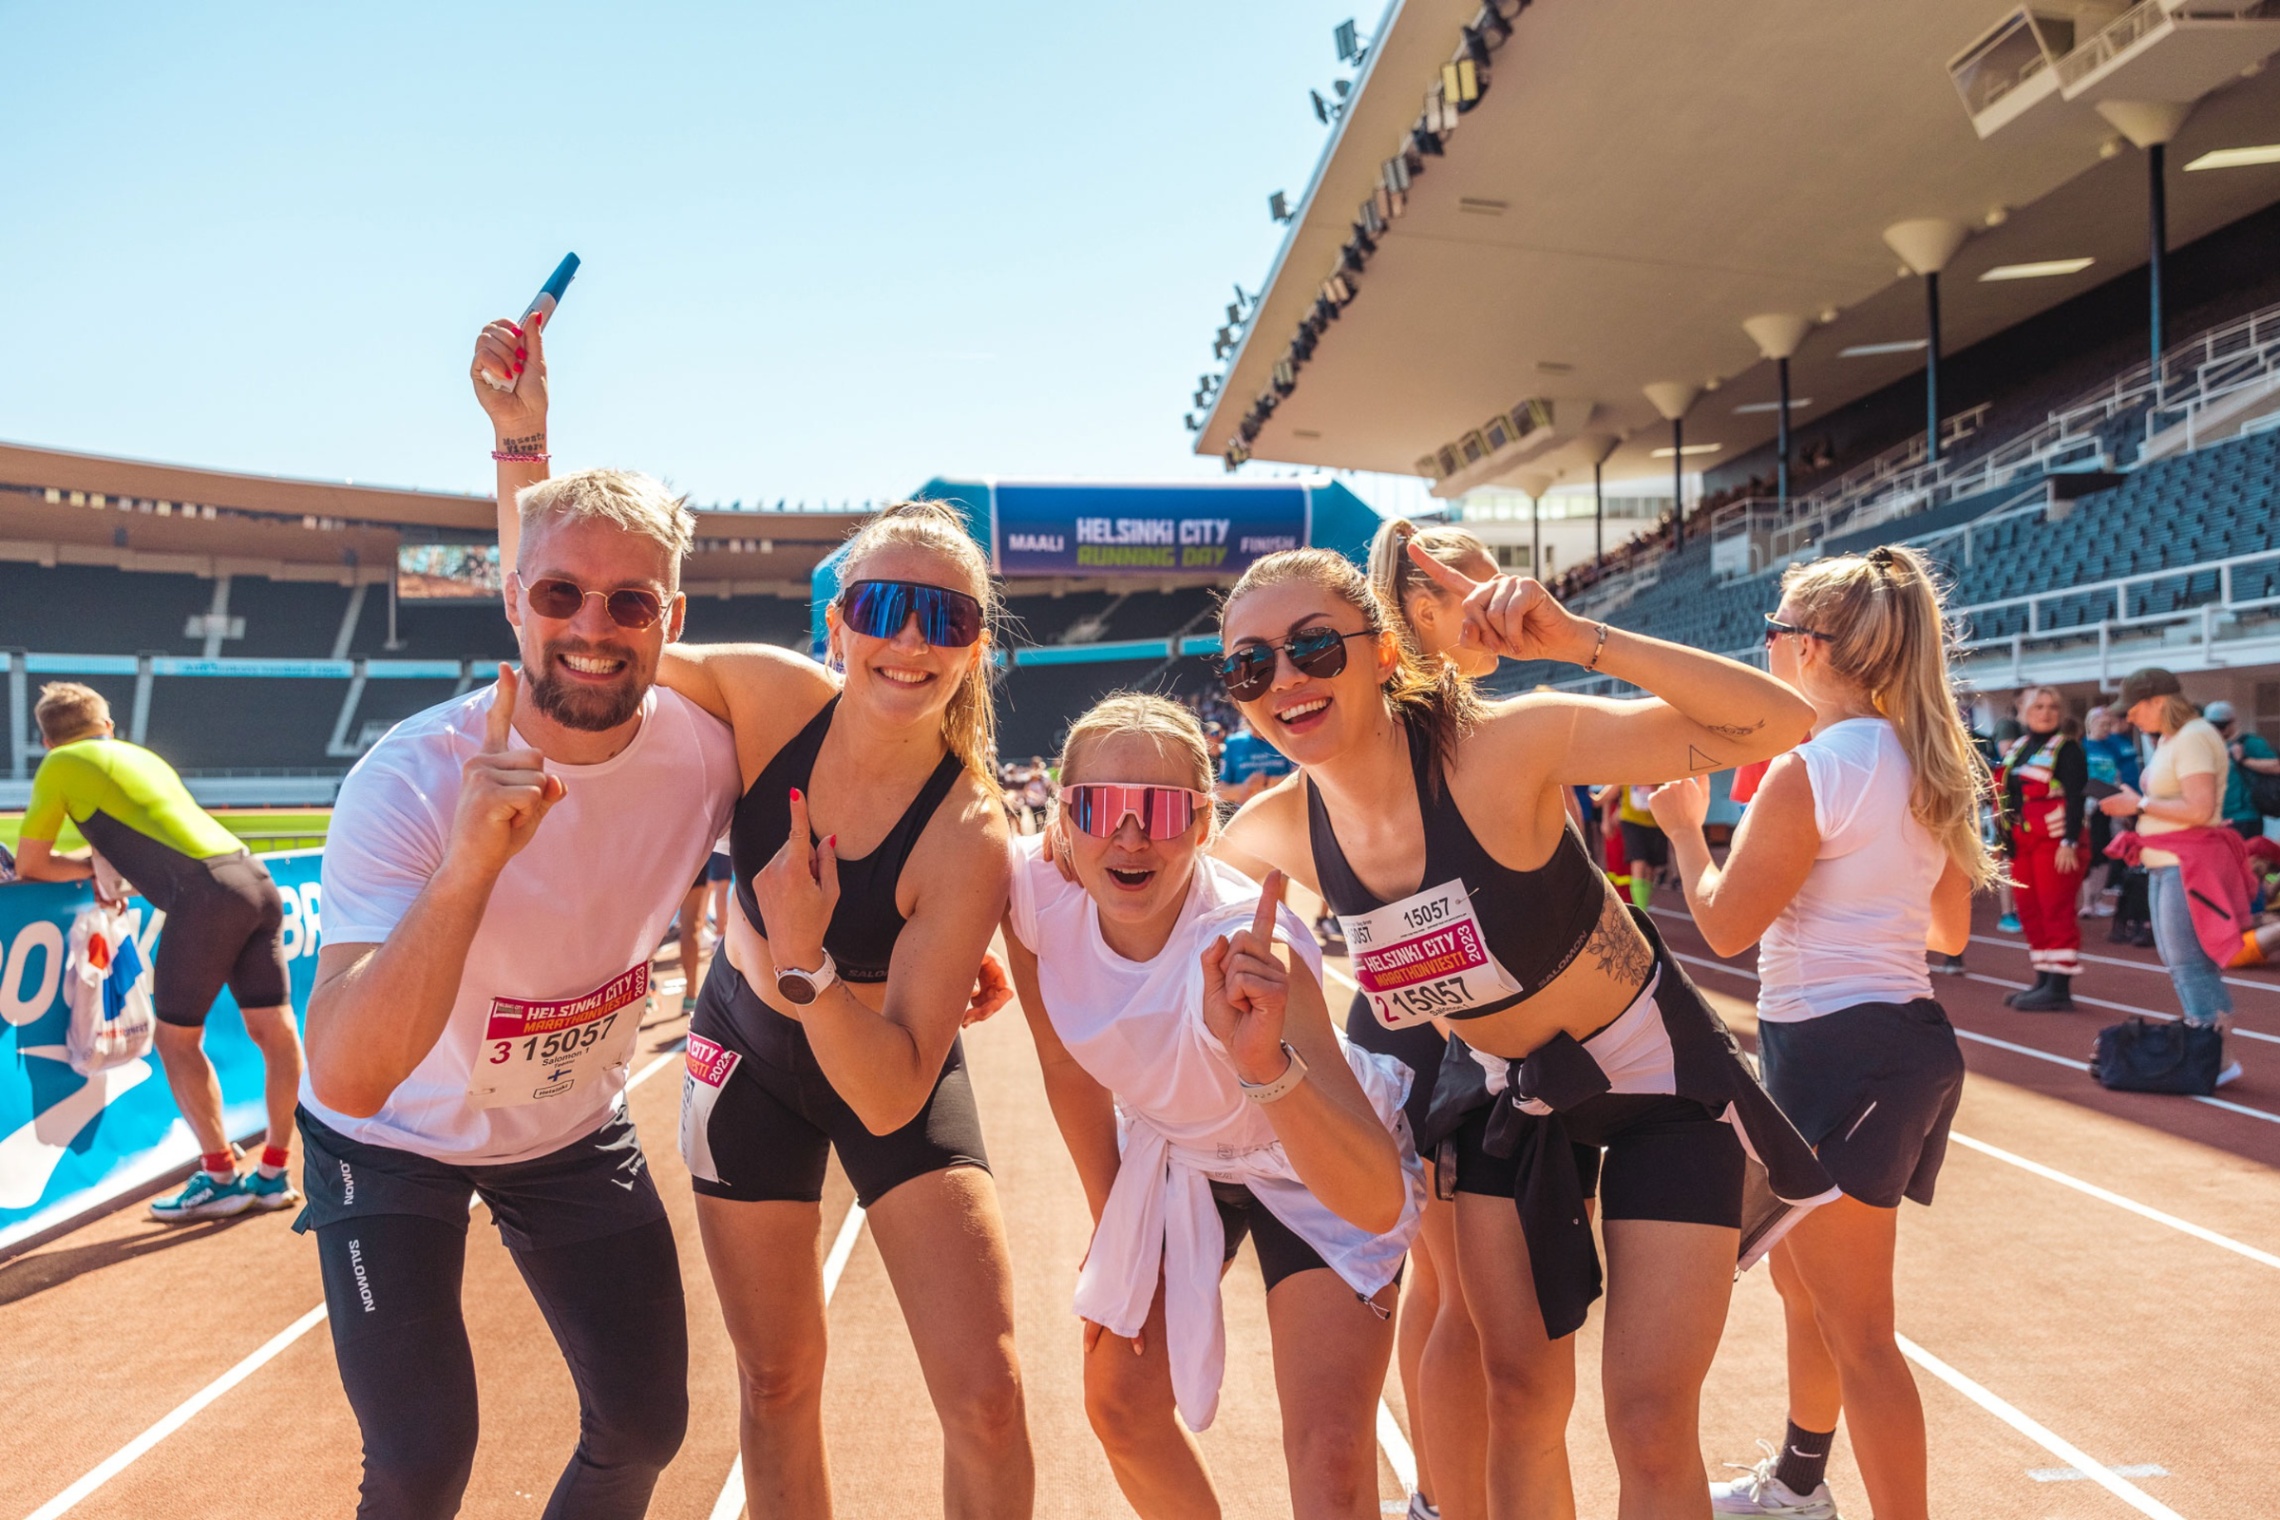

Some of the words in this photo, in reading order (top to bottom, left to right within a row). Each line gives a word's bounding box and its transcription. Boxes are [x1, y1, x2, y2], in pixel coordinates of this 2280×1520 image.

[1009, 534, 1065, 552] MAALI
[1076, 518, 1174, 544] HELSINKI
[1179, 518, 1231, 544] CITY
[1240, 536, 1296, 553] FINISH
[1077, 546, 1176, 566] RUNNING
[1181, 546, 1227, 566] DAY
[1403, 897, 1450, 929] 15057
[1364, 943, 1424, 973] HELSINKI
[1422, 932, 1456, 958] CITY
[1457, 924, 1482, 963] 2023
[1538, 930, 1588, 988] SALOMON
[634, 966, 645, 997] 2023
[847, 969, 889, 978] SALO
[1373, 951, 1467, 987] MARATHONVIESTI
[523, 990, 633, 1033] MARATHONVIESTI
[526, 992, 602, 1021] HELSINKI
[605, 973, 633, 1001] CITY
[1375, 995, 1400, 1023] 2
[1392, 976, 1475, 1016] 15057
[489, 1041, 512, 1064] 3
[523, 1013, 618, 1061] 15057
[691, 1040, 719, 1062] CITY
[542, 1050, 582, 1066] Salomon
[348, 1239, 376, 1313] SALOMON
